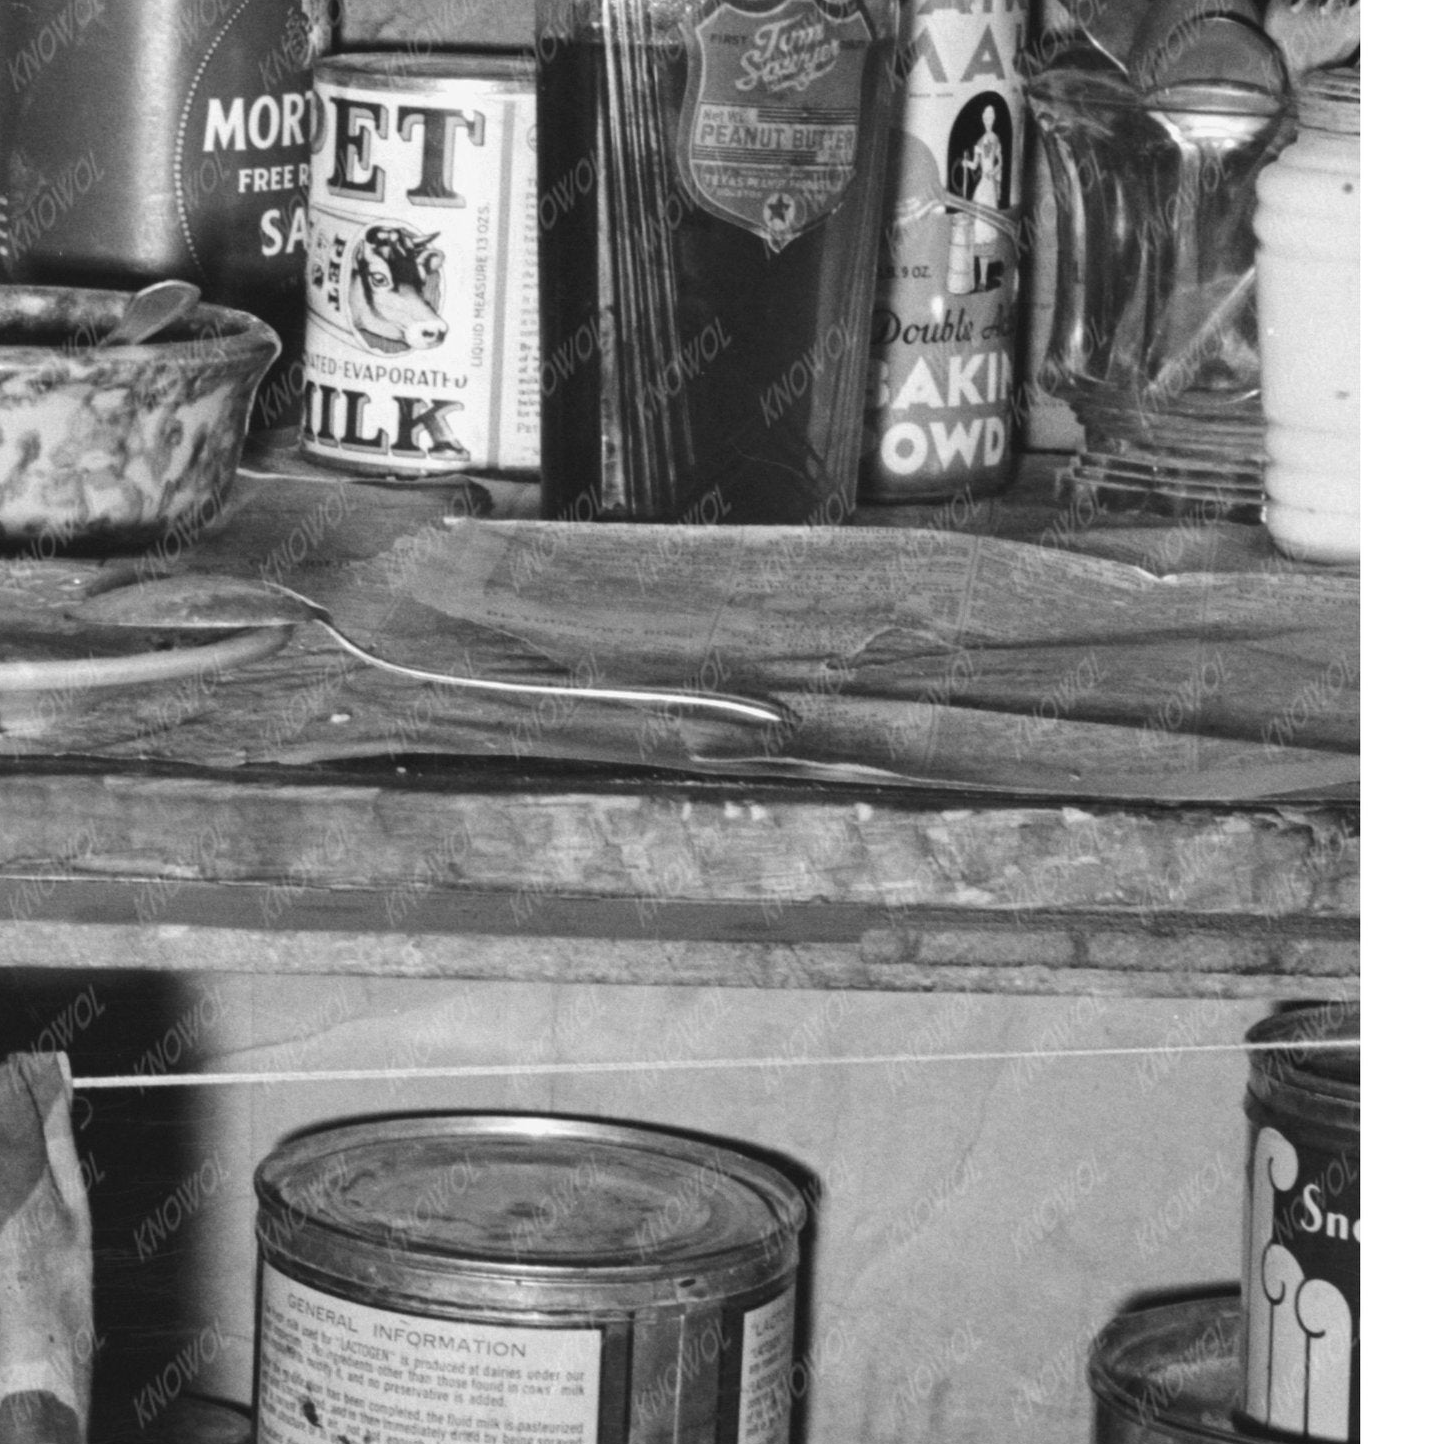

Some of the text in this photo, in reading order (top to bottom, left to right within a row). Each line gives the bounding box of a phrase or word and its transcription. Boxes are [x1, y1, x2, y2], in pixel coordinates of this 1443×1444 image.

[755, 14, 825, 60] Tom
[700, 123, 787, 151] PEANUT
[237, 165, 295, 194] FREE
[473, 255, 489, 320] MEASURE
[870, 308, 974, 346] Double
[287, 1292, 529, 1359] GENERAL INFORMATION
